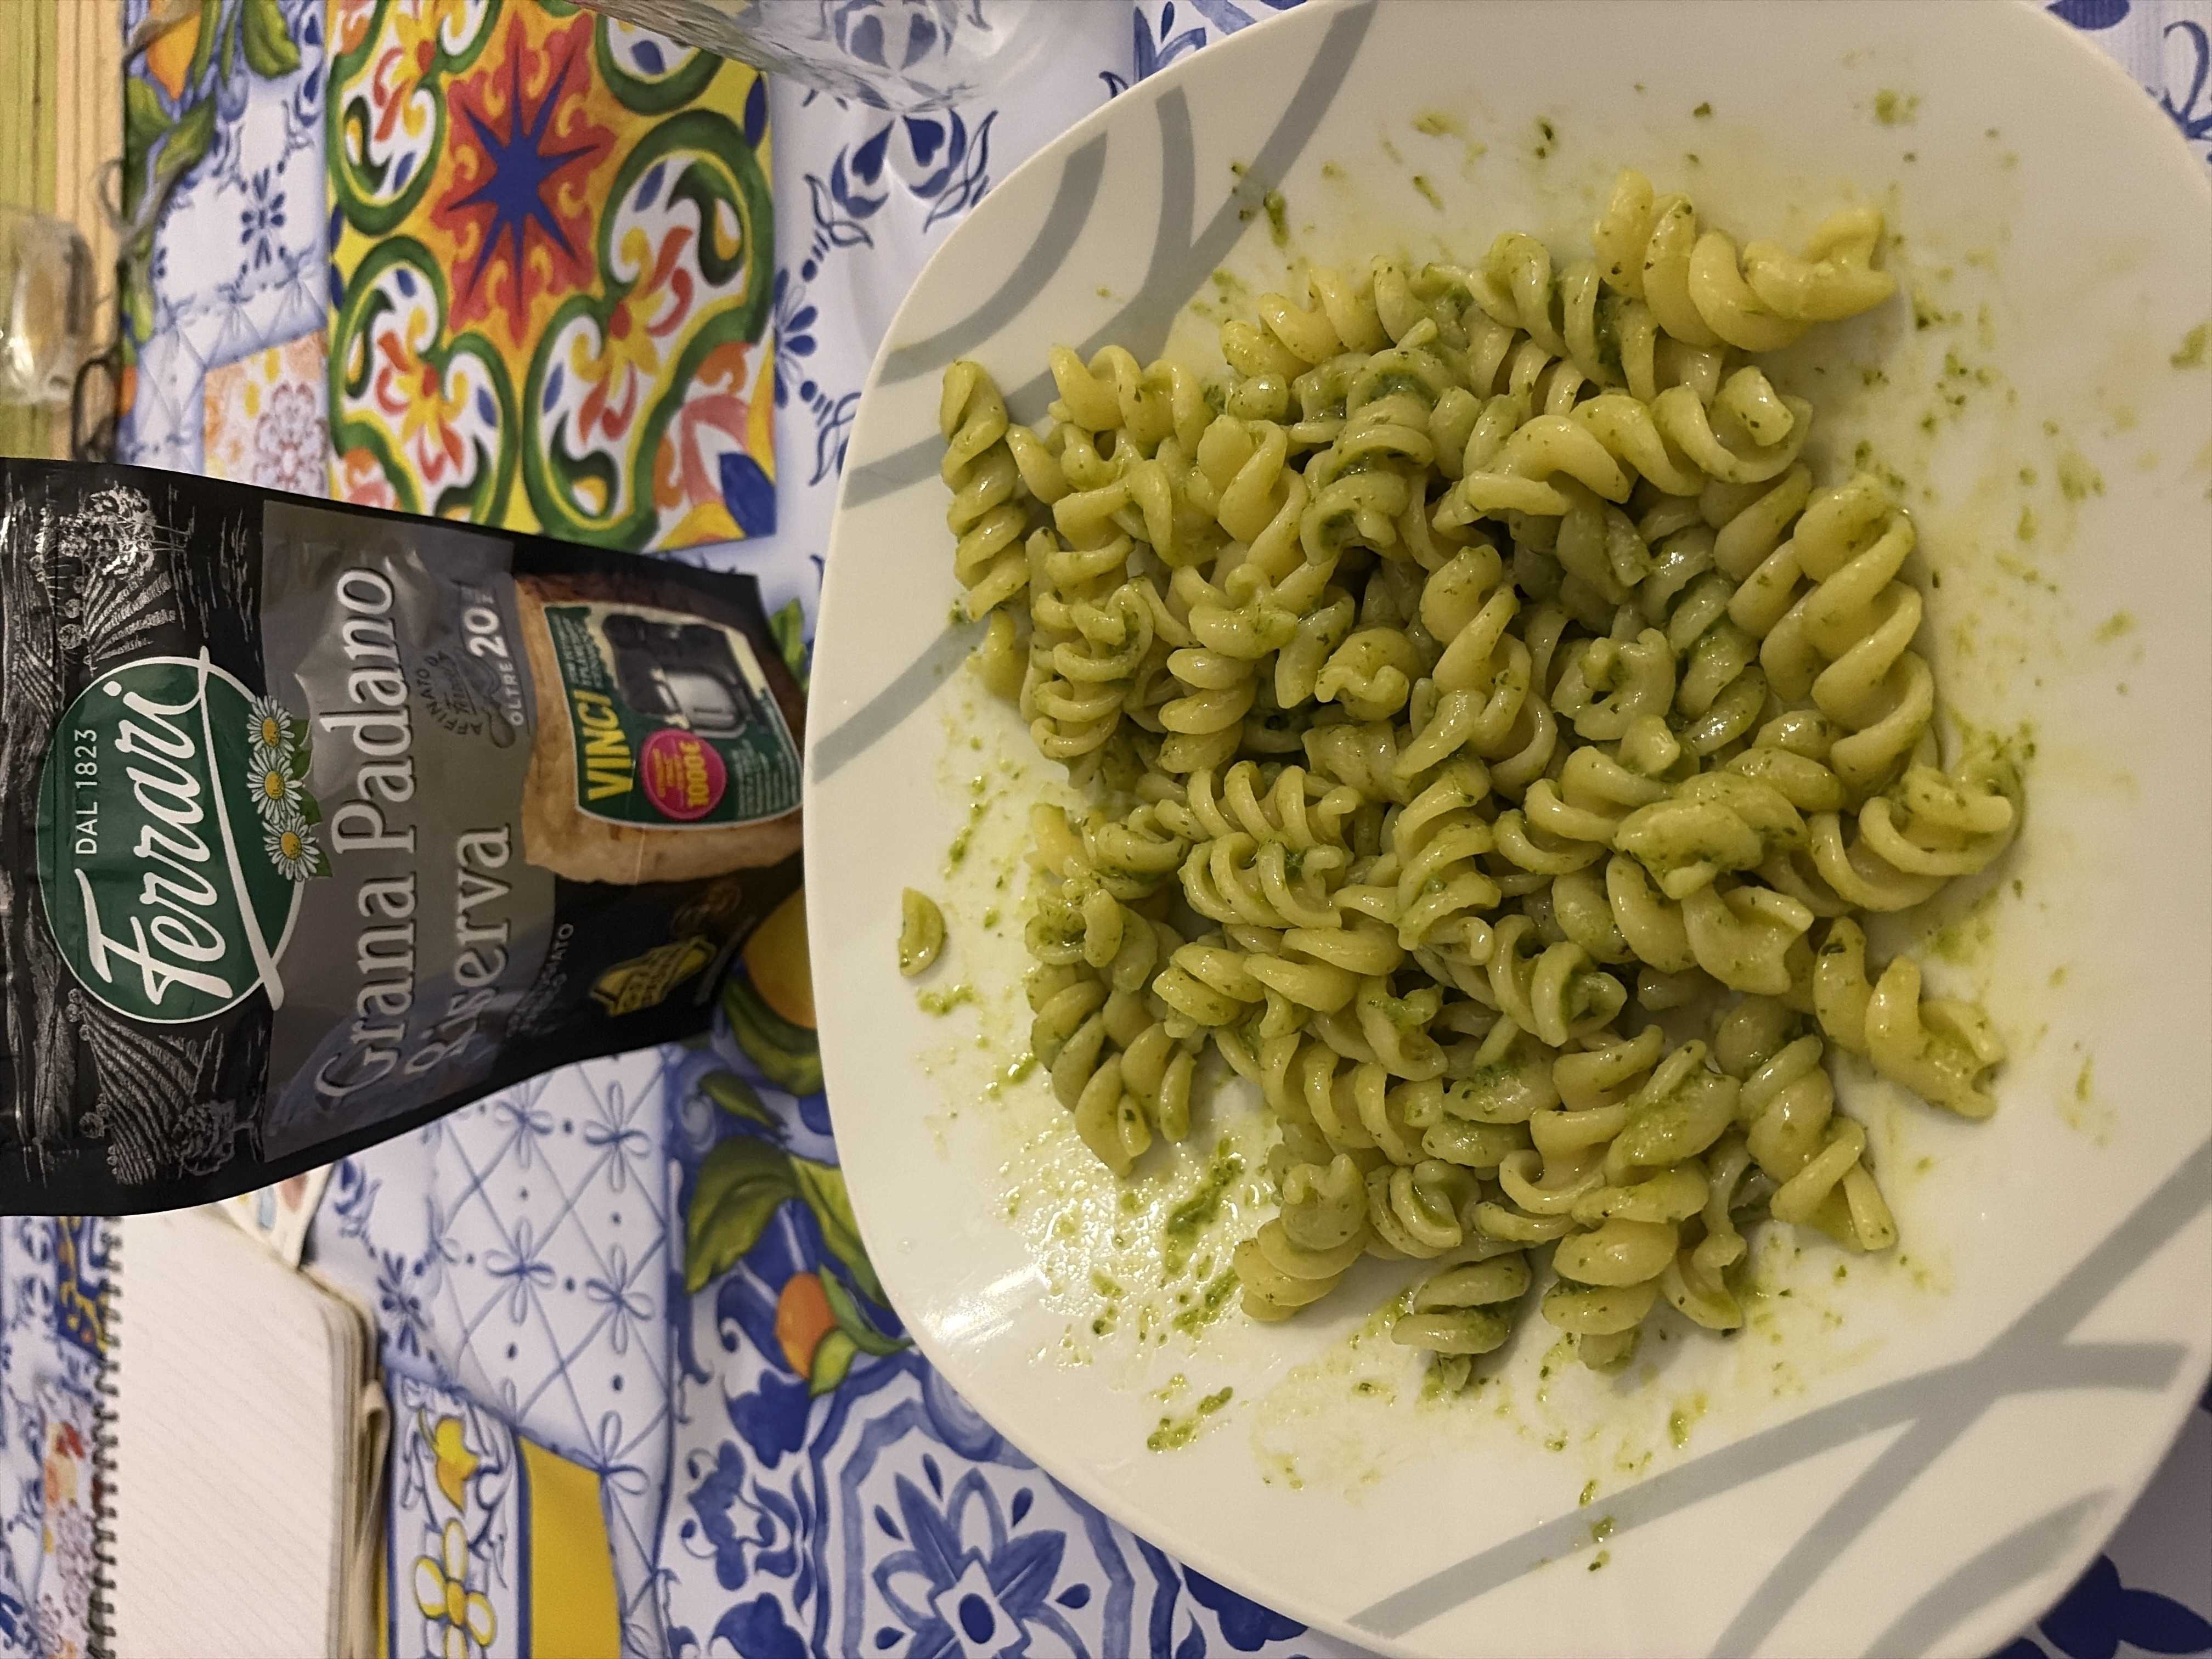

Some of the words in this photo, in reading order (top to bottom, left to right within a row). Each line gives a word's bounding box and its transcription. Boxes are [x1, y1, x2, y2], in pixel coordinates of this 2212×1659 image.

[462, 606, 509, 657] 20
[318, 566, 415, 854] Padano
[415, 667, 483, 736] AFFINATO
[499, 661, 524, 726] OLTRE
[74, 728, 98, 788] 1823
[572, 688, 634, 800] VINCI
[75, 800, 99, 854] DAL
[75, 679, 234, 1006] Ferrari
[314, 871, 417, 1096] Grana
[403, 823, 512, 1074] Riserva
